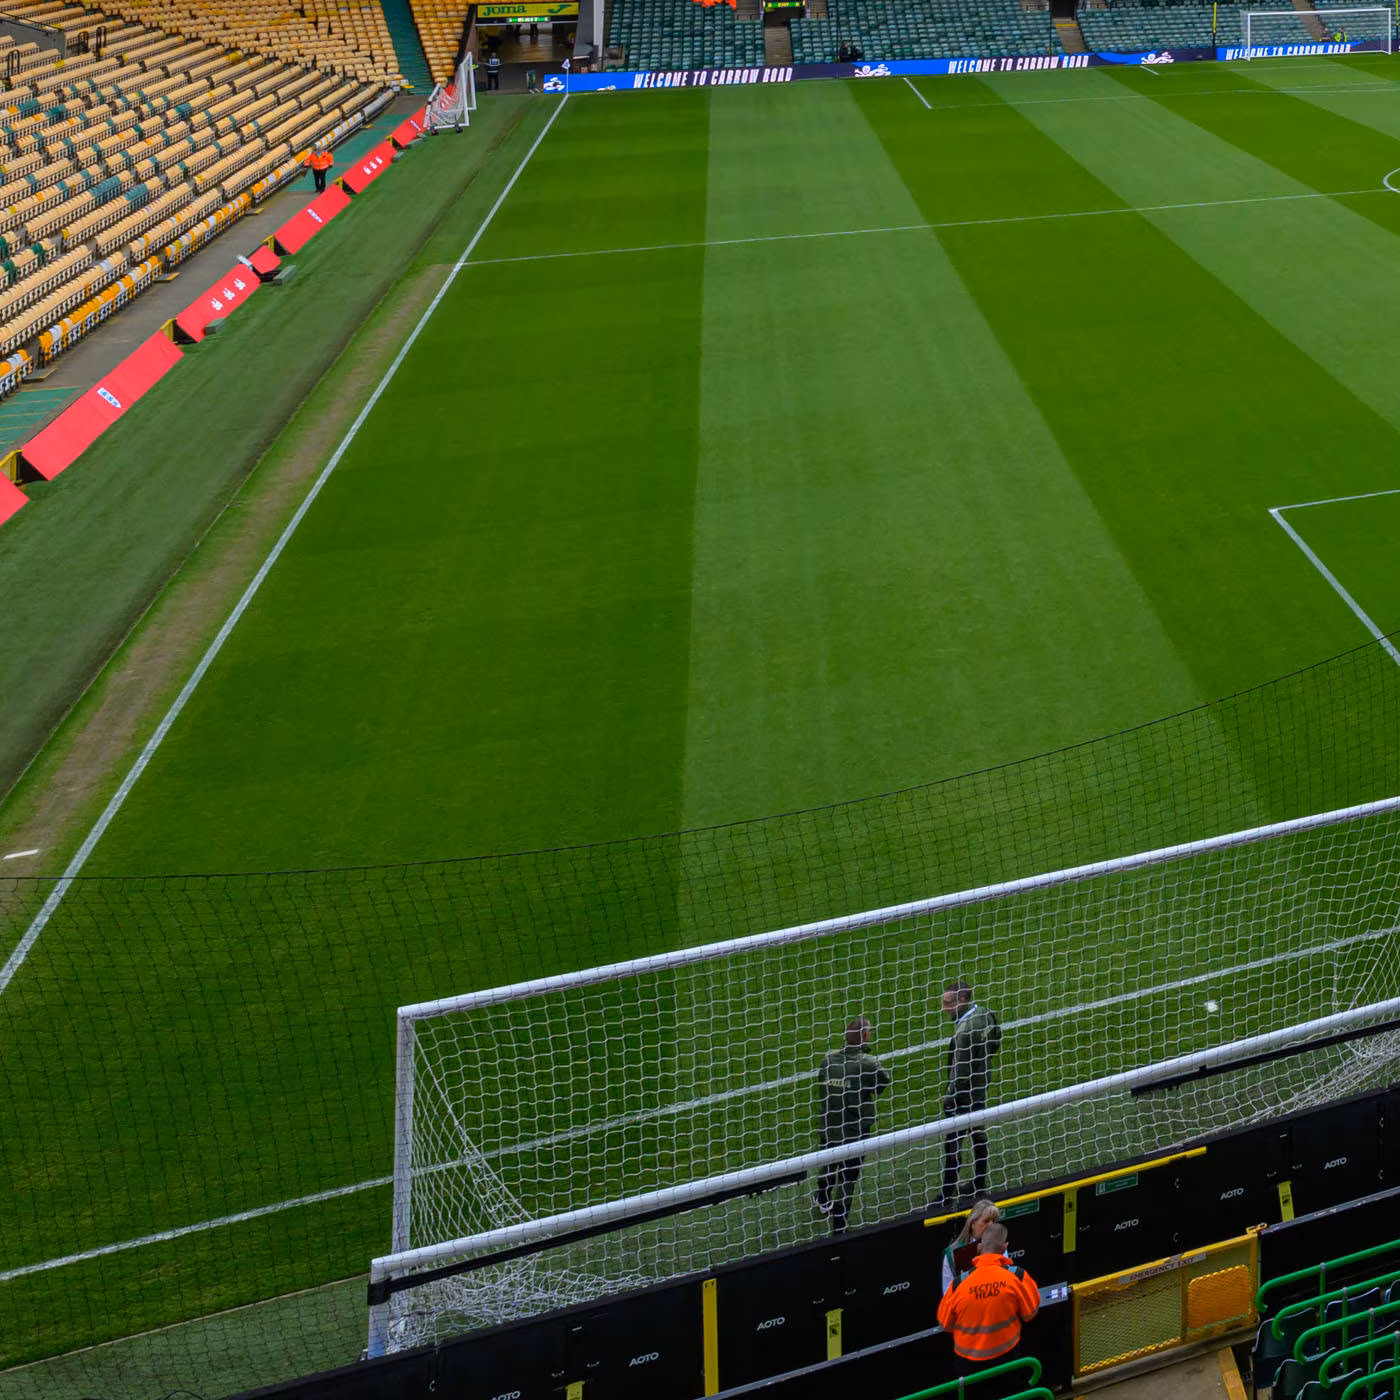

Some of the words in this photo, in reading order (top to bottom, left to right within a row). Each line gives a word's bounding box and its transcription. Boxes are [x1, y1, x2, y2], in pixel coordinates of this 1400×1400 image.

[482, 5, 526, 17] Joma
[948, 59, 996, 74] WELCOME
[1000, 58, 1013, 71] TO
[1016, 56, 1059, 70] CARROW
[1062, 55, 1089, 68] ROAD
[634, 71, 688, 88] WELCOME
[693, 71, 707, 86] TO
[711, 68, 759, 85] CARROW
[762, 67, 793, 83] ROAD
[1324, 1157, 1347, 1169] AOTO
[1221, 1188, 1244, 1200] AOTO
[1114, 1219, 1139, 1231] AOTO
[883, 1282, 910, 1295] AOTO
[970, 1280, 1007, 1294] SECTION
[976, 1289, 1000, 1299] HEAD
[757, 1317, 785, 1331] AOTO
[629, 1352, 659, 1367] AOTO
